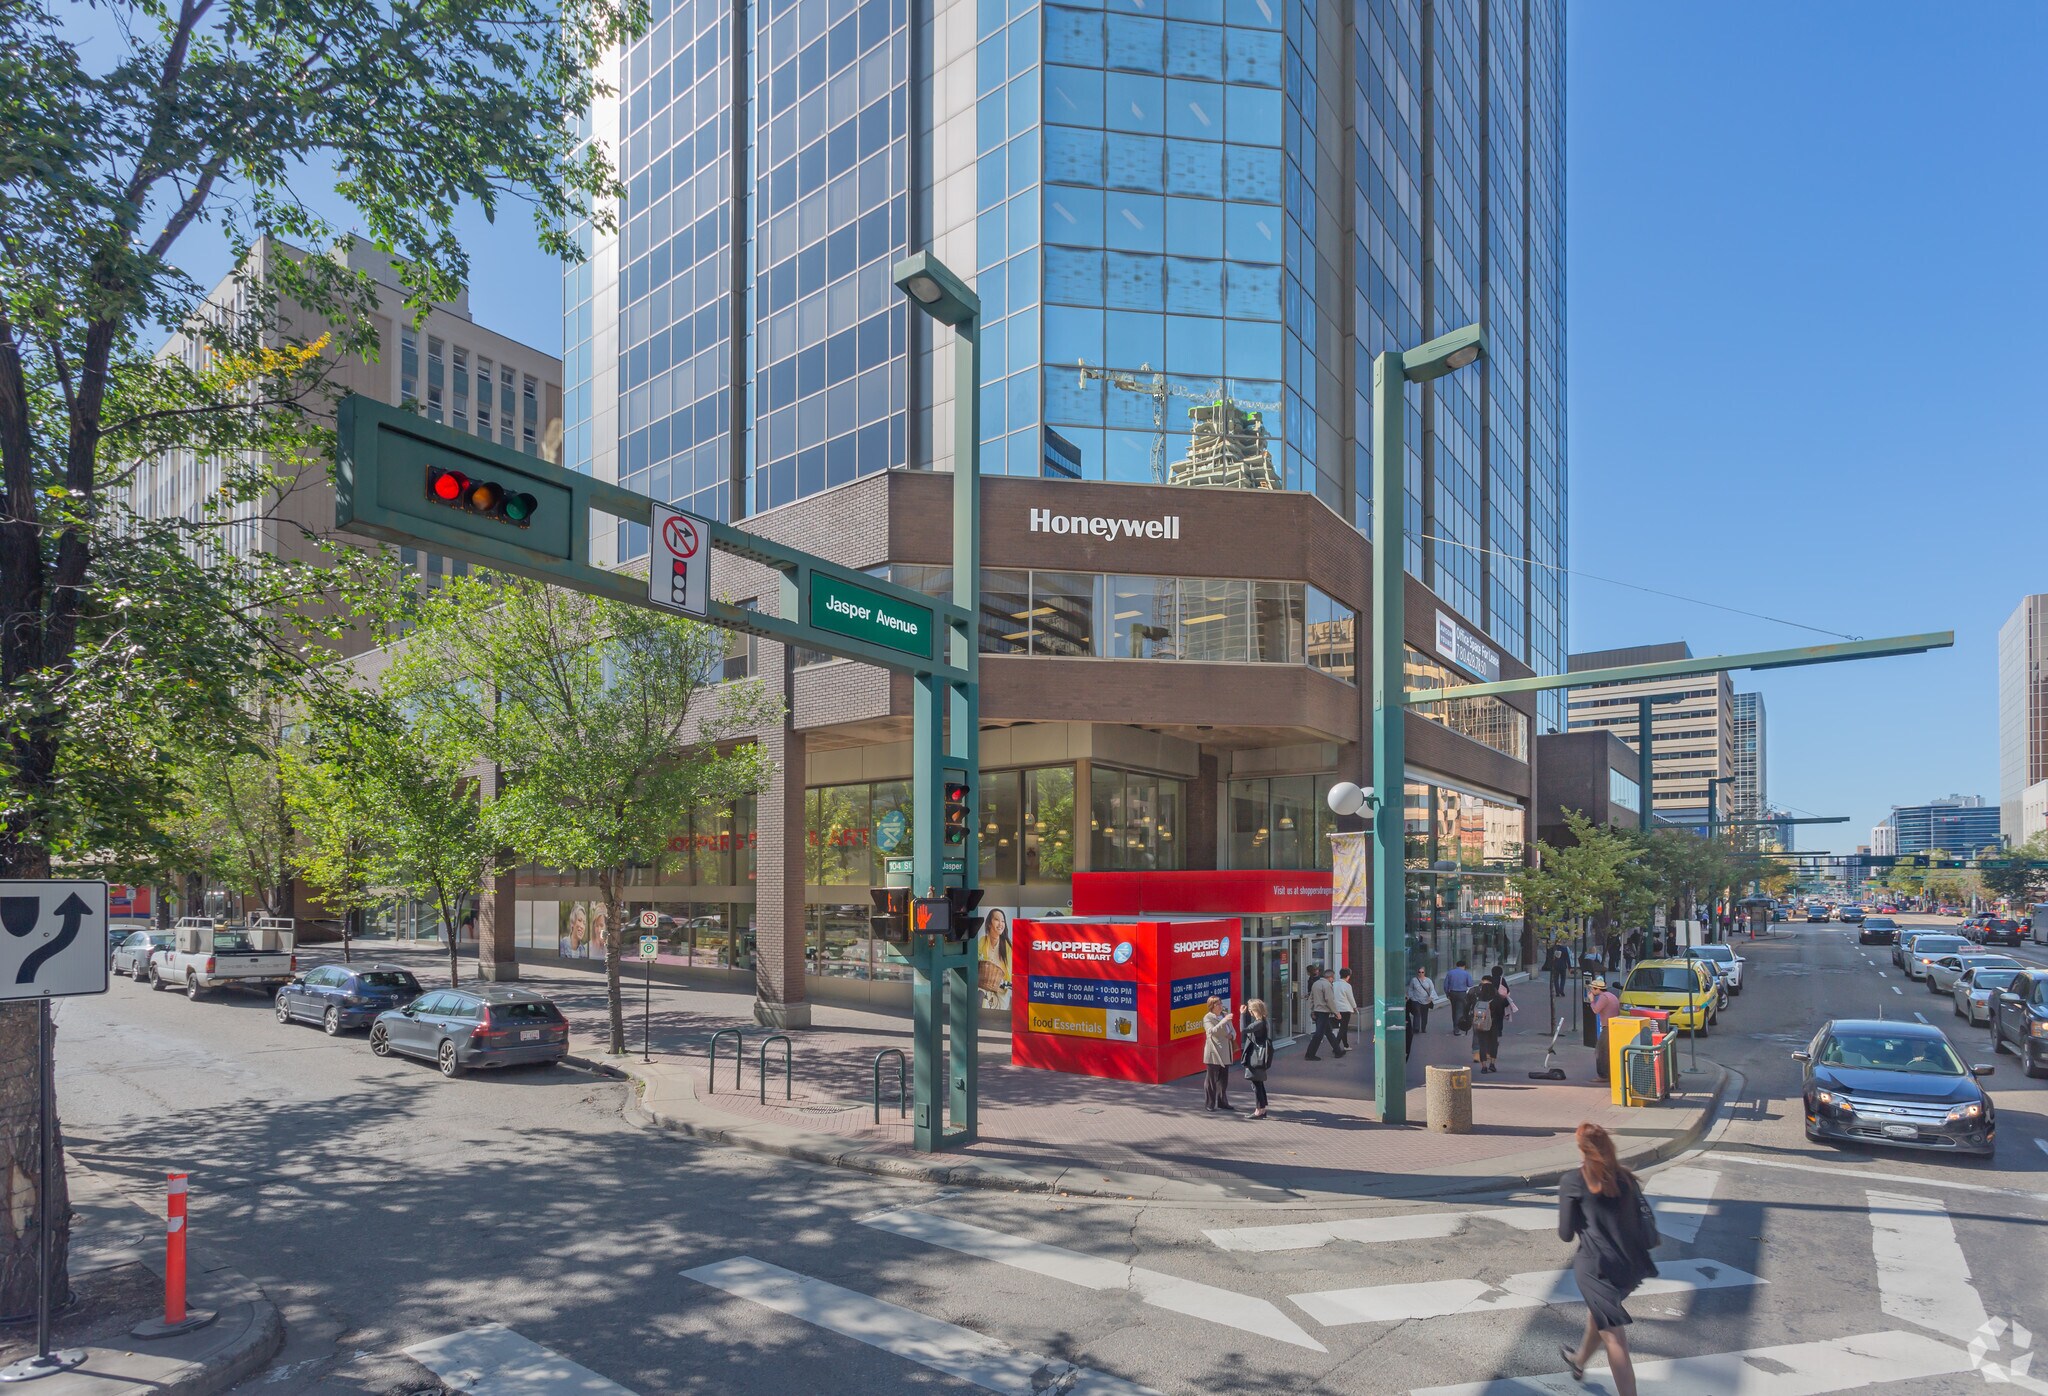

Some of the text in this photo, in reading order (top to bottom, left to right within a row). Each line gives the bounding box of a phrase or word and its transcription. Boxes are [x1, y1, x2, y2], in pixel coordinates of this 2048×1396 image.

[1030, 508, 1180, 542] Honeywell
[825, 594, 918, 636] Jasper Avenue
[1456, 627, 1469, 647] Office
[1470, 637, 1482, 655] Space
[890, 862, 901, 870] 104
[942, 862, 962, 872] Jasper
[1273, 885, 1286, 895] Visit
[1294, 886, 1299, 894] at
[1032, 940, 1112, 953] SHOPPERS
[1173, 939, 1220, 953] SHOPPERS
